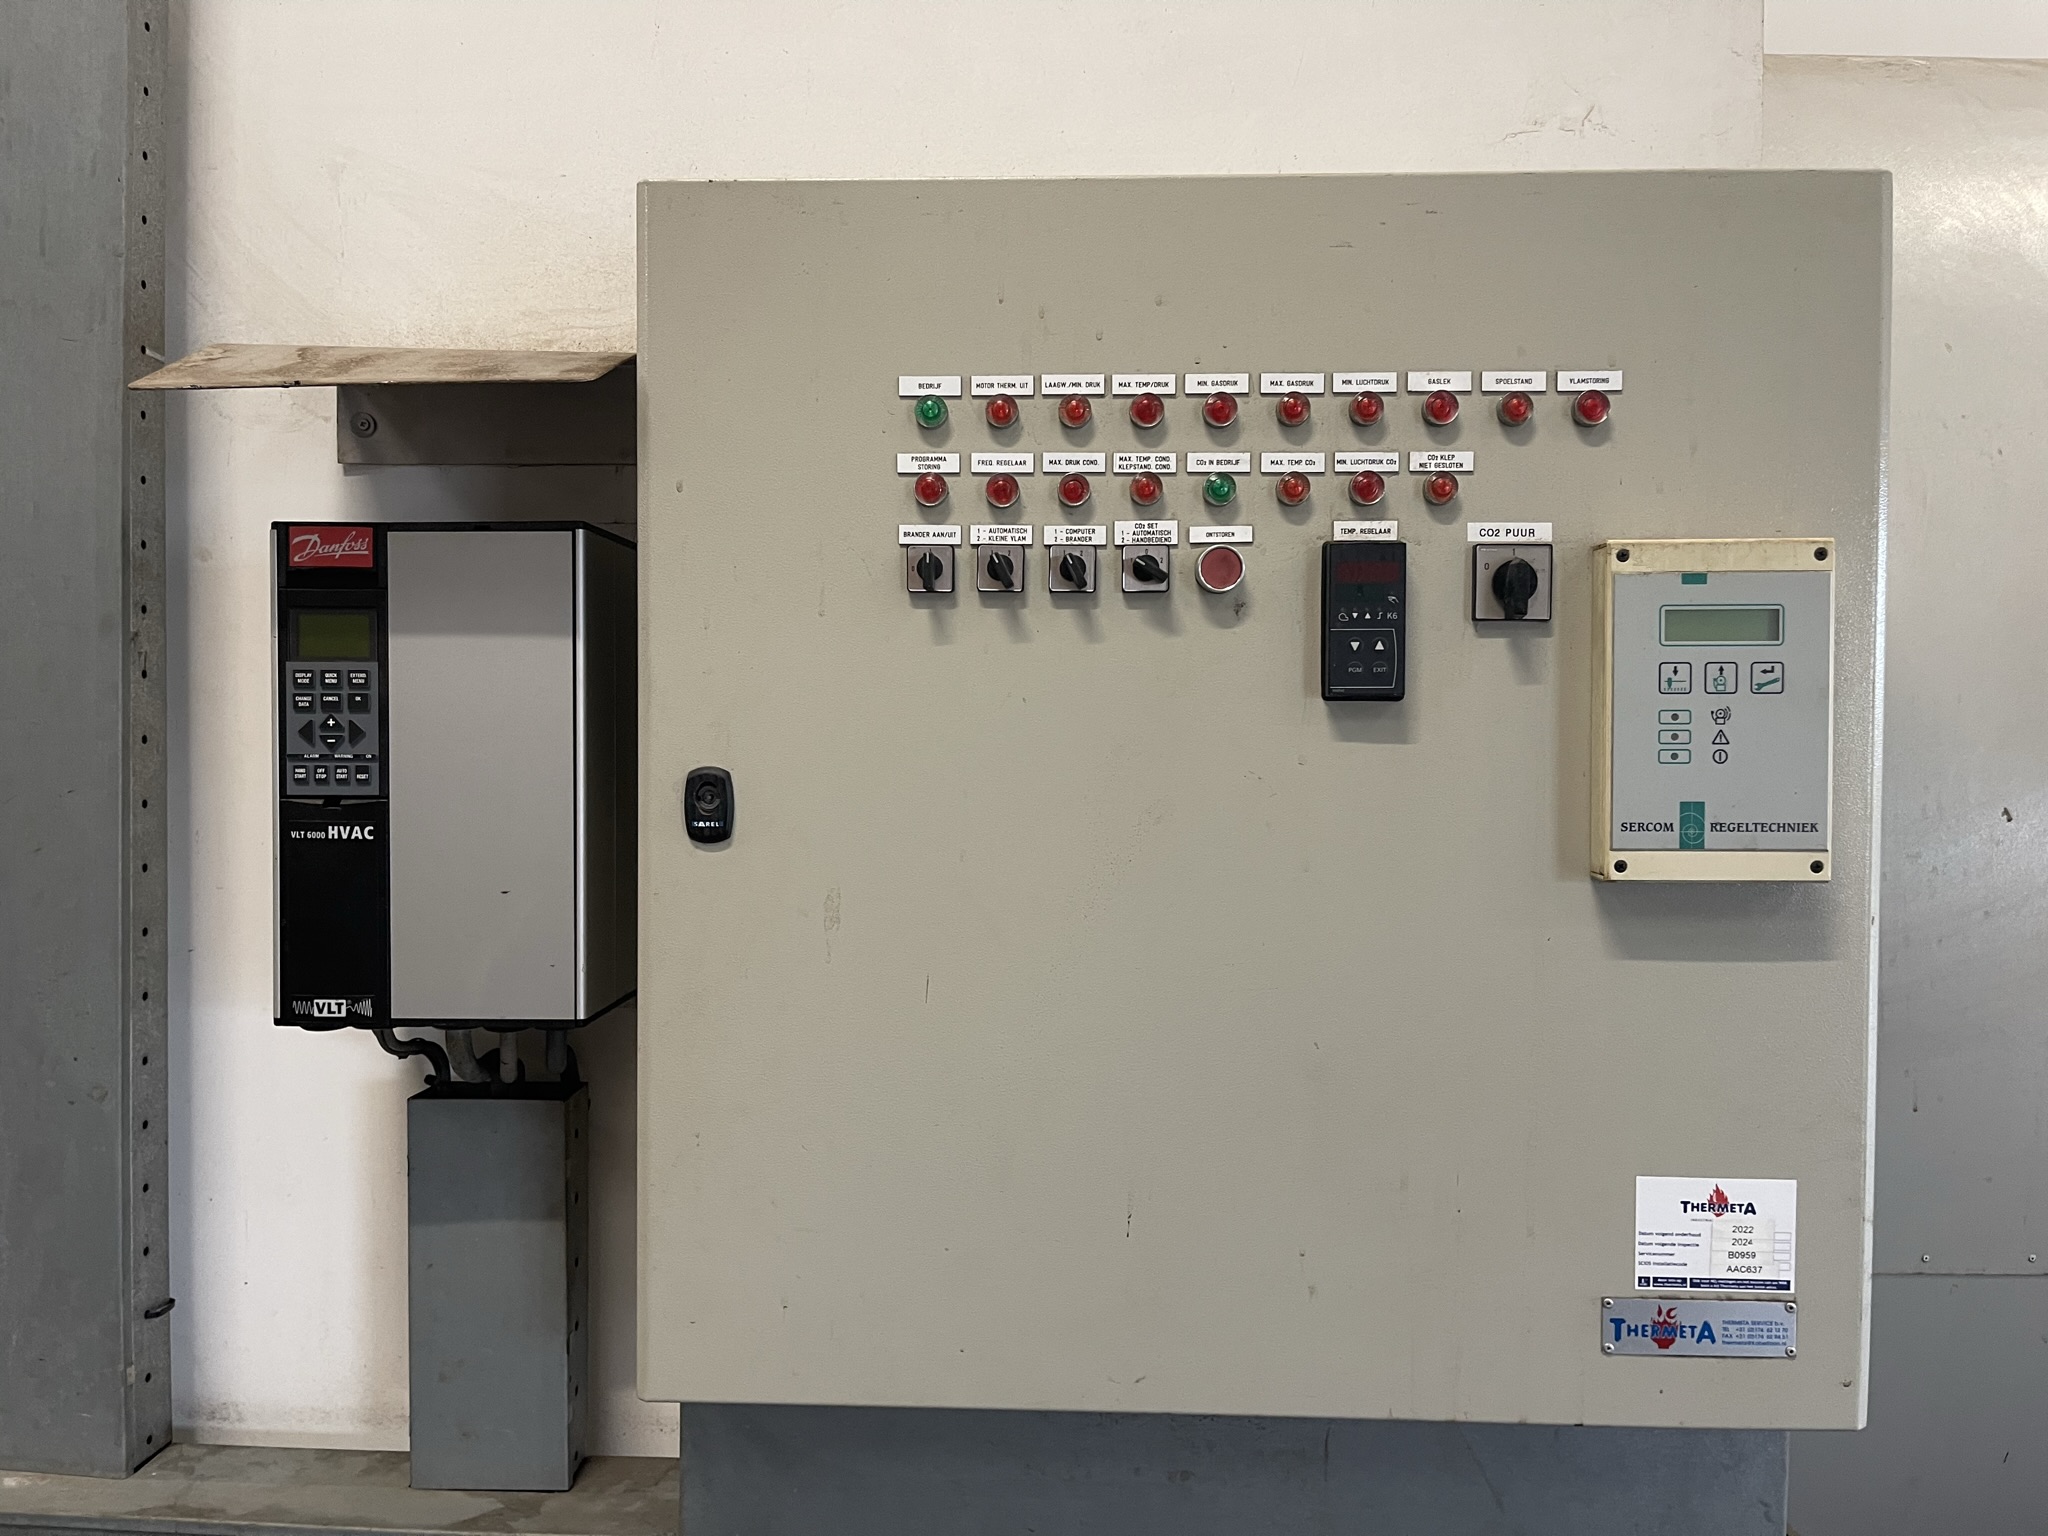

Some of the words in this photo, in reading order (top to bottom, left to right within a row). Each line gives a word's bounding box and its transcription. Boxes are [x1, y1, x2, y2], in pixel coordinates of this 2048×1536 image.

[1479, 529, 1500, 537] CO2
[1505, 529, 1535, 537] PUUR
[292, 530, 369, 562] Danfoss
[1387, 612, 1398, 620] K6
[291, 831, 305, 839] VLT
[306, 831, 326, 839] 6000
[328, 825, 374, 840] HVAC
[1620, 822, 1675, 833] SERCOM
[1710, 822, 1819, 833] REGELTECHNIEK
[315, 1002, 344, 1014] VLT
[1680, 1200, 1756, 1215] THERMETA
[1732, 1226, 1754, 1234] 2022
[1731, 1238, 1753, 1246] 2024
[1726, 1266, 1762, 1274] AAC637
[1609, 1318, 1716, 1344] THERMETA
